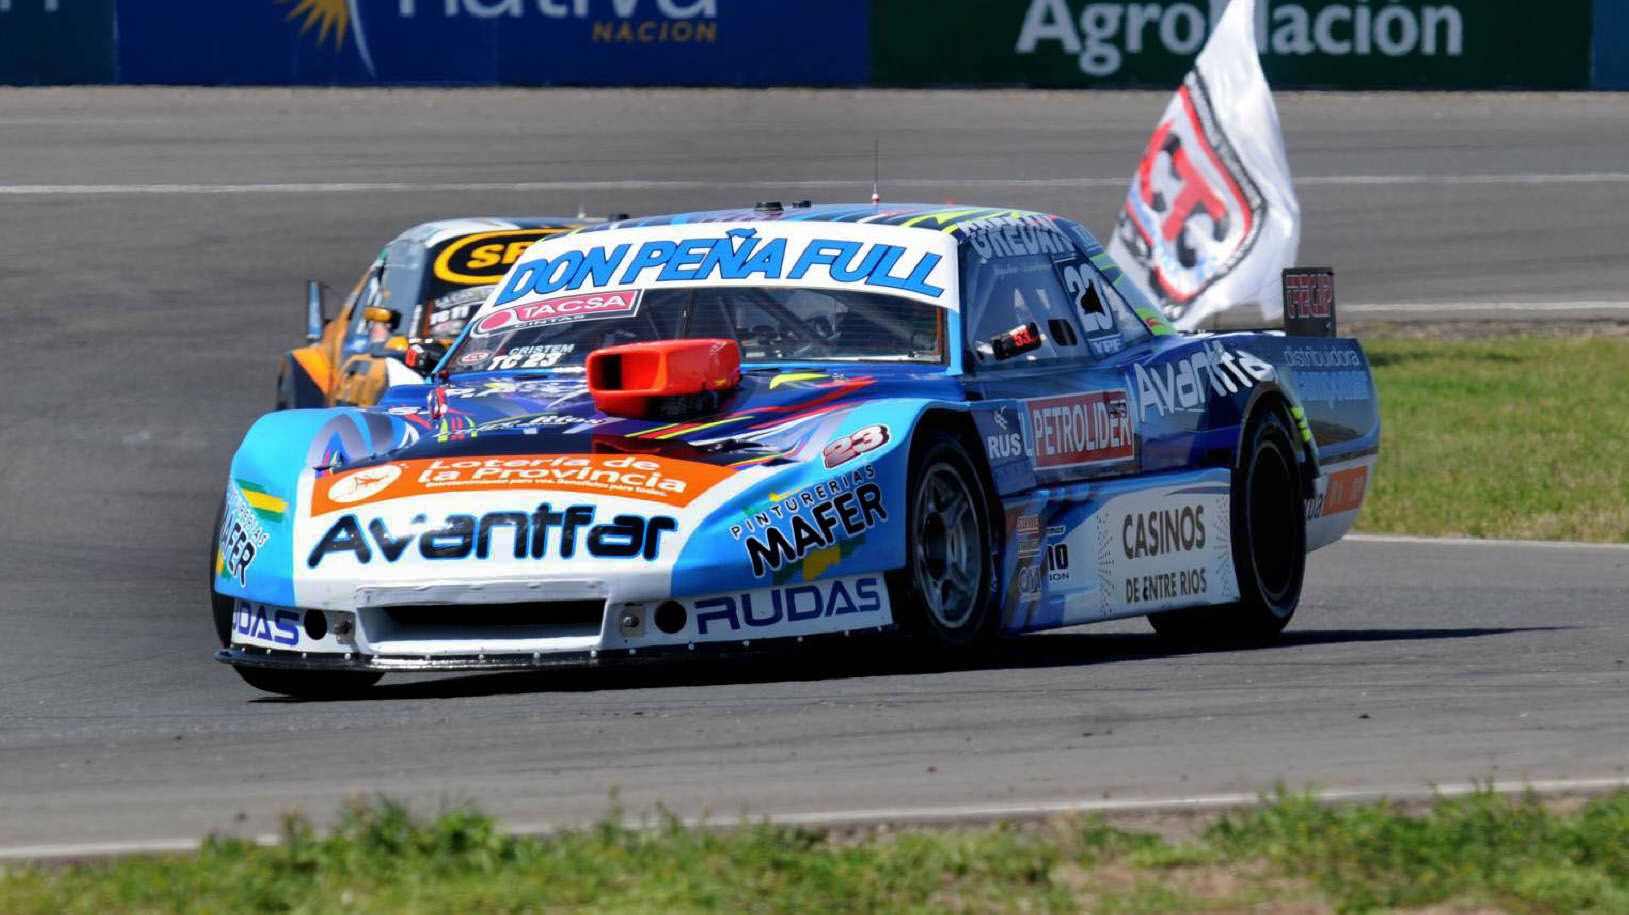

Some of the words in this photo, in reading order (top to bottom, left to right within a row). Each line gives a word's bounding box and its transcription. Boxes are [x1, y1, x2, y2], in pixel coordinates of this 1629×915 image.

[592, 21, 717, 43] NACION
[495, 243, 629, 305] DON
[620, 227, 788, 285] PEÑA
[786, 239, 945, 298] FULL
[523, 295, 627, 318] TACSA
[822, 425, 891, 470] 23
[987, 433, 1022, 460] RUS
[1032, 399, 1132, 457] PETROLIDER
[418, 468, 461, 483] la
[471, 466, 687, 494] Provincia
[602, 456, 660, 471] de
[730, 464, 876, 541] PINTURERIAS
[307, 502, 681, 570] Avantfar
[745, 482, 890, 579] MAFER
[1122, 504, 1206, 560] CASINOS
[694, 578, 882, 635] RUDAS
[1126, 578, 1139, 604] DE
[1143, 571, 1177, 602] ENTRE
[1180, 568, 1208, 597] RIOS
